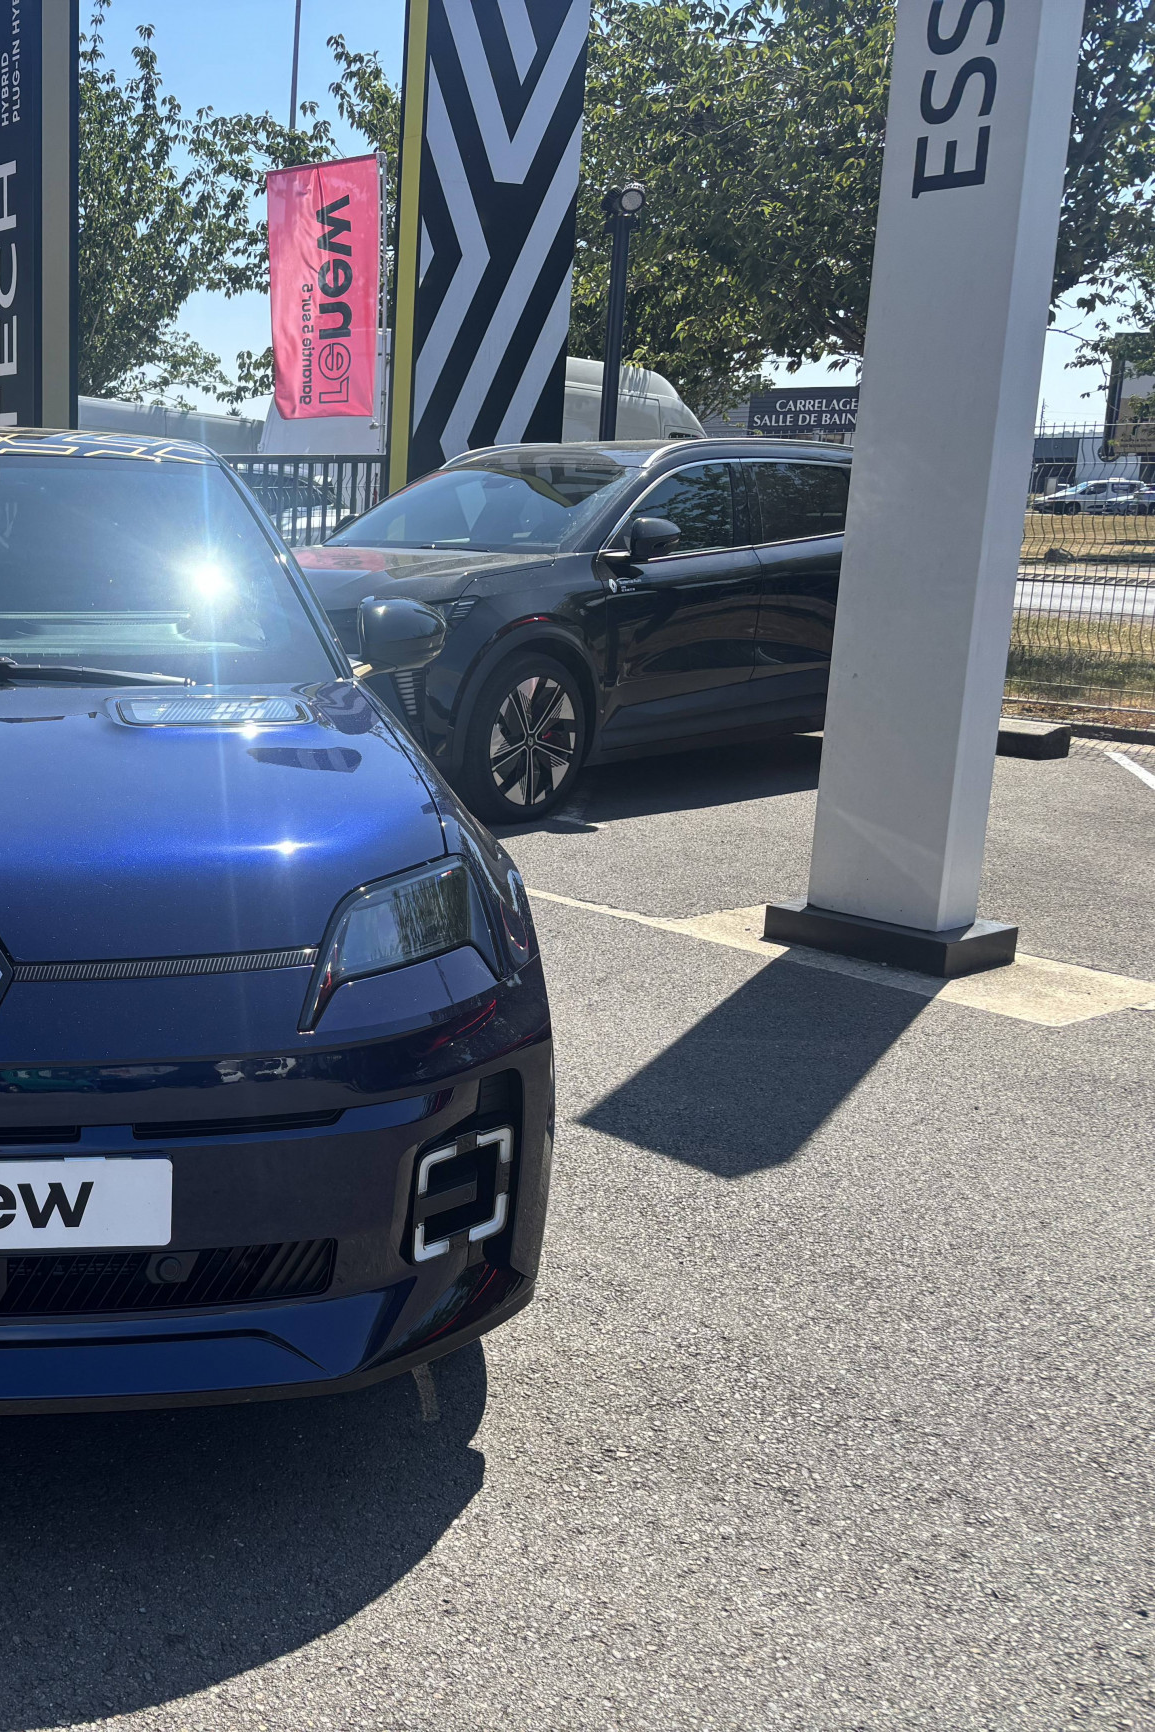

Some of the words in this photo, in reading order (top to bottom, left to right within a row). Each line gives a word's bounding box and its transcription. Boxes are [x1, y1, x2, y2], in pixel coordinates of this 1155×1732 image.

[12, 39, 21, 122] PLUG-IN
[911, 0, 1006, 199] ESS
[753, 414, 794, 426] SALLE
[798, 414, 818, 425] DE
